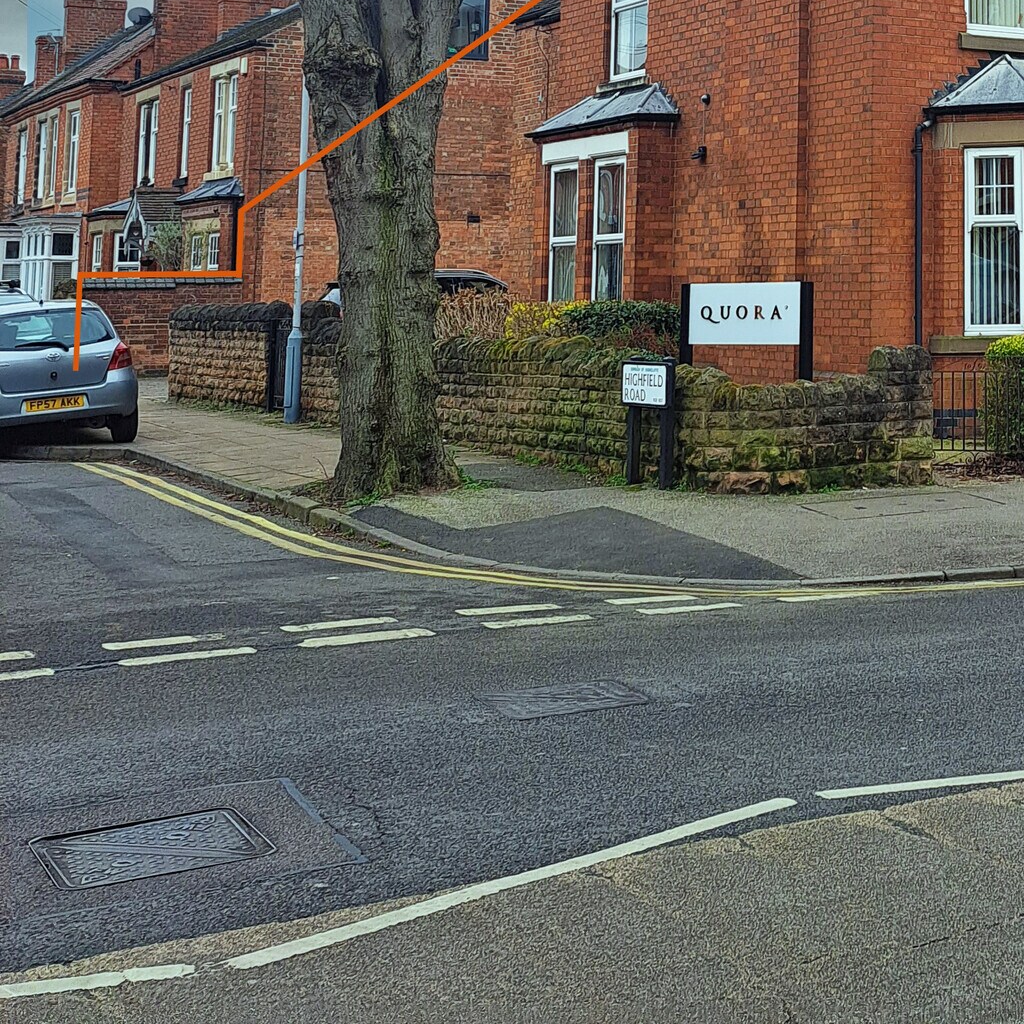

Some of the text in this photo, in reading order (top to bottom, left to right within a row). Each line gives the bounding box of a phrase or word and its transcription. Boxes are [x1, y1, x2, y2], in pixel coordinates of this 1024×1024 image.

[624, 373, 664, 388] HIGHFIELD
[624, 387, 647, 402] ROAD
[29, 396, 80, 411] FP57 AKK
